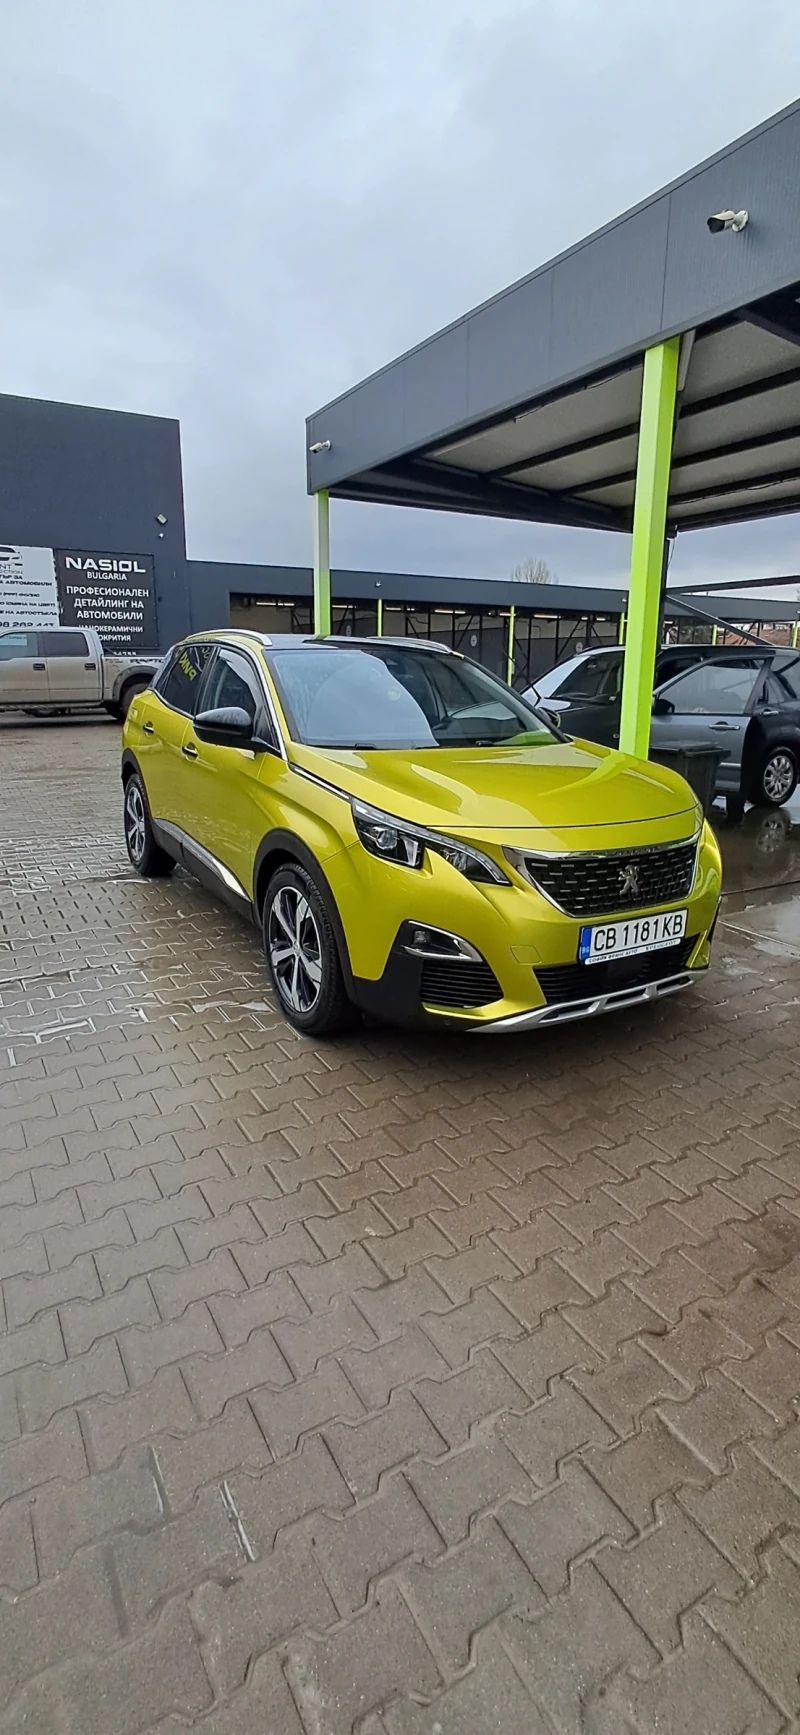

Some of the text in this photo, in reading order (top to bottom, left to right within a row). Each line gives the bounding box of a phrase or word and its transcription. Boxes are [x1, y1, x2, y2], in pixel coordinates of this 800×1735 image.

[65, 557, 146, 573] NASIOL
[87, 571, 127, 581] BULGARIA
[66, 586, 149, 598] ПРОФЕСИОНАЛЕН
[73, 597, 144, 609] ДЕТАЙЛИНГ НА
[77, 610, 143, 621] АВТОМОБИЛИ
[98, 634, 131, 642] ОКРИТИЯ
[593, 927, 617, 952] CB
